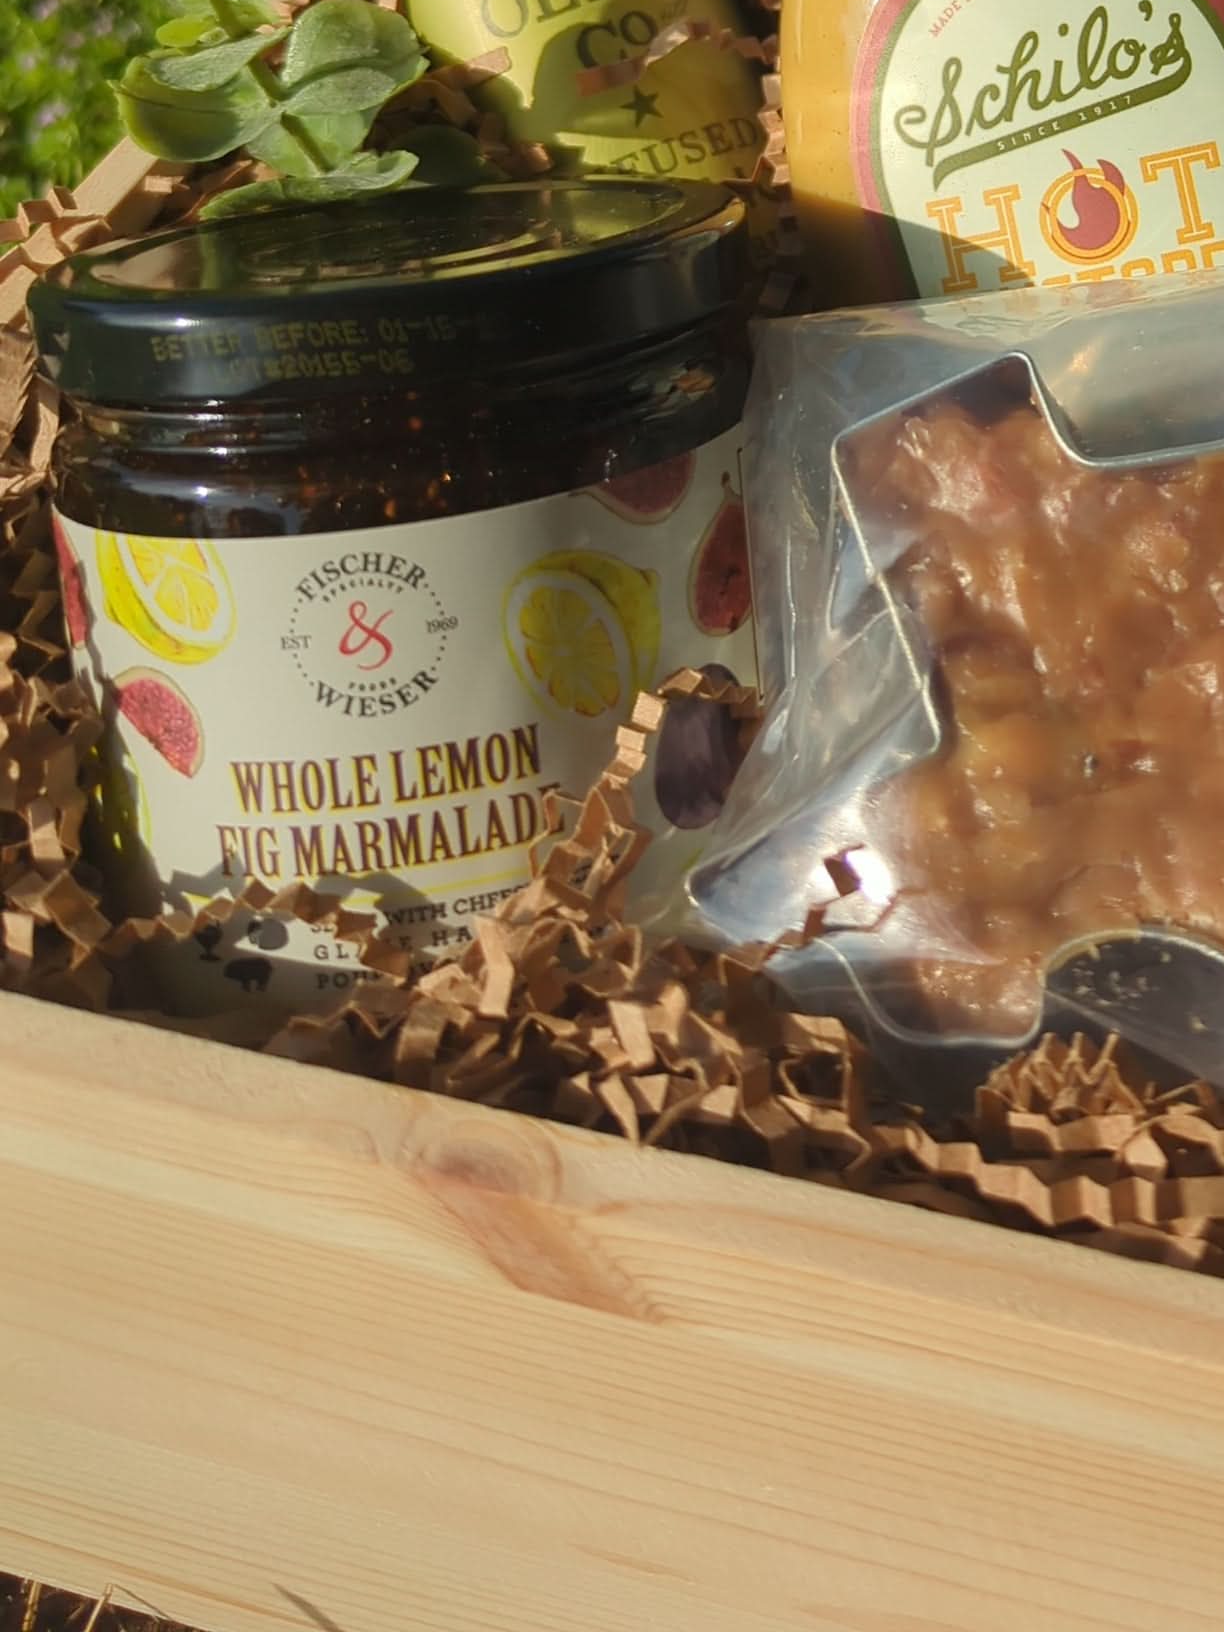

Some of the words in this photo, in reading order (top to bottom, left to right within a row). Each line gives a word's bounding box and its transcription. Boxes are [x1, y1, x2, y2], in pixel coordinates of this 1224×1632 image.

[929, 0, 962, 38] MADE
[894, 0, 1193, 168] Schilo's
[997, 121, 1061, 151] SINCE
[1078, 95, 1131, 121] 1917
[926, 140, 1221, 295] HOT
[295, 552, 426, 601] FISCHER
[280, 636, 312, 650] EST
[339, 600, 394, 671] &
[426, 616, 459, 634] 1969
[313, 670, 439, 717] WIESER
[230, 755, 382, 813] WHOLE
[389, 722, 542, 803] LEMON
[216, 824, 282, 878] FIG
[383, 903, 446, 925] WITH
